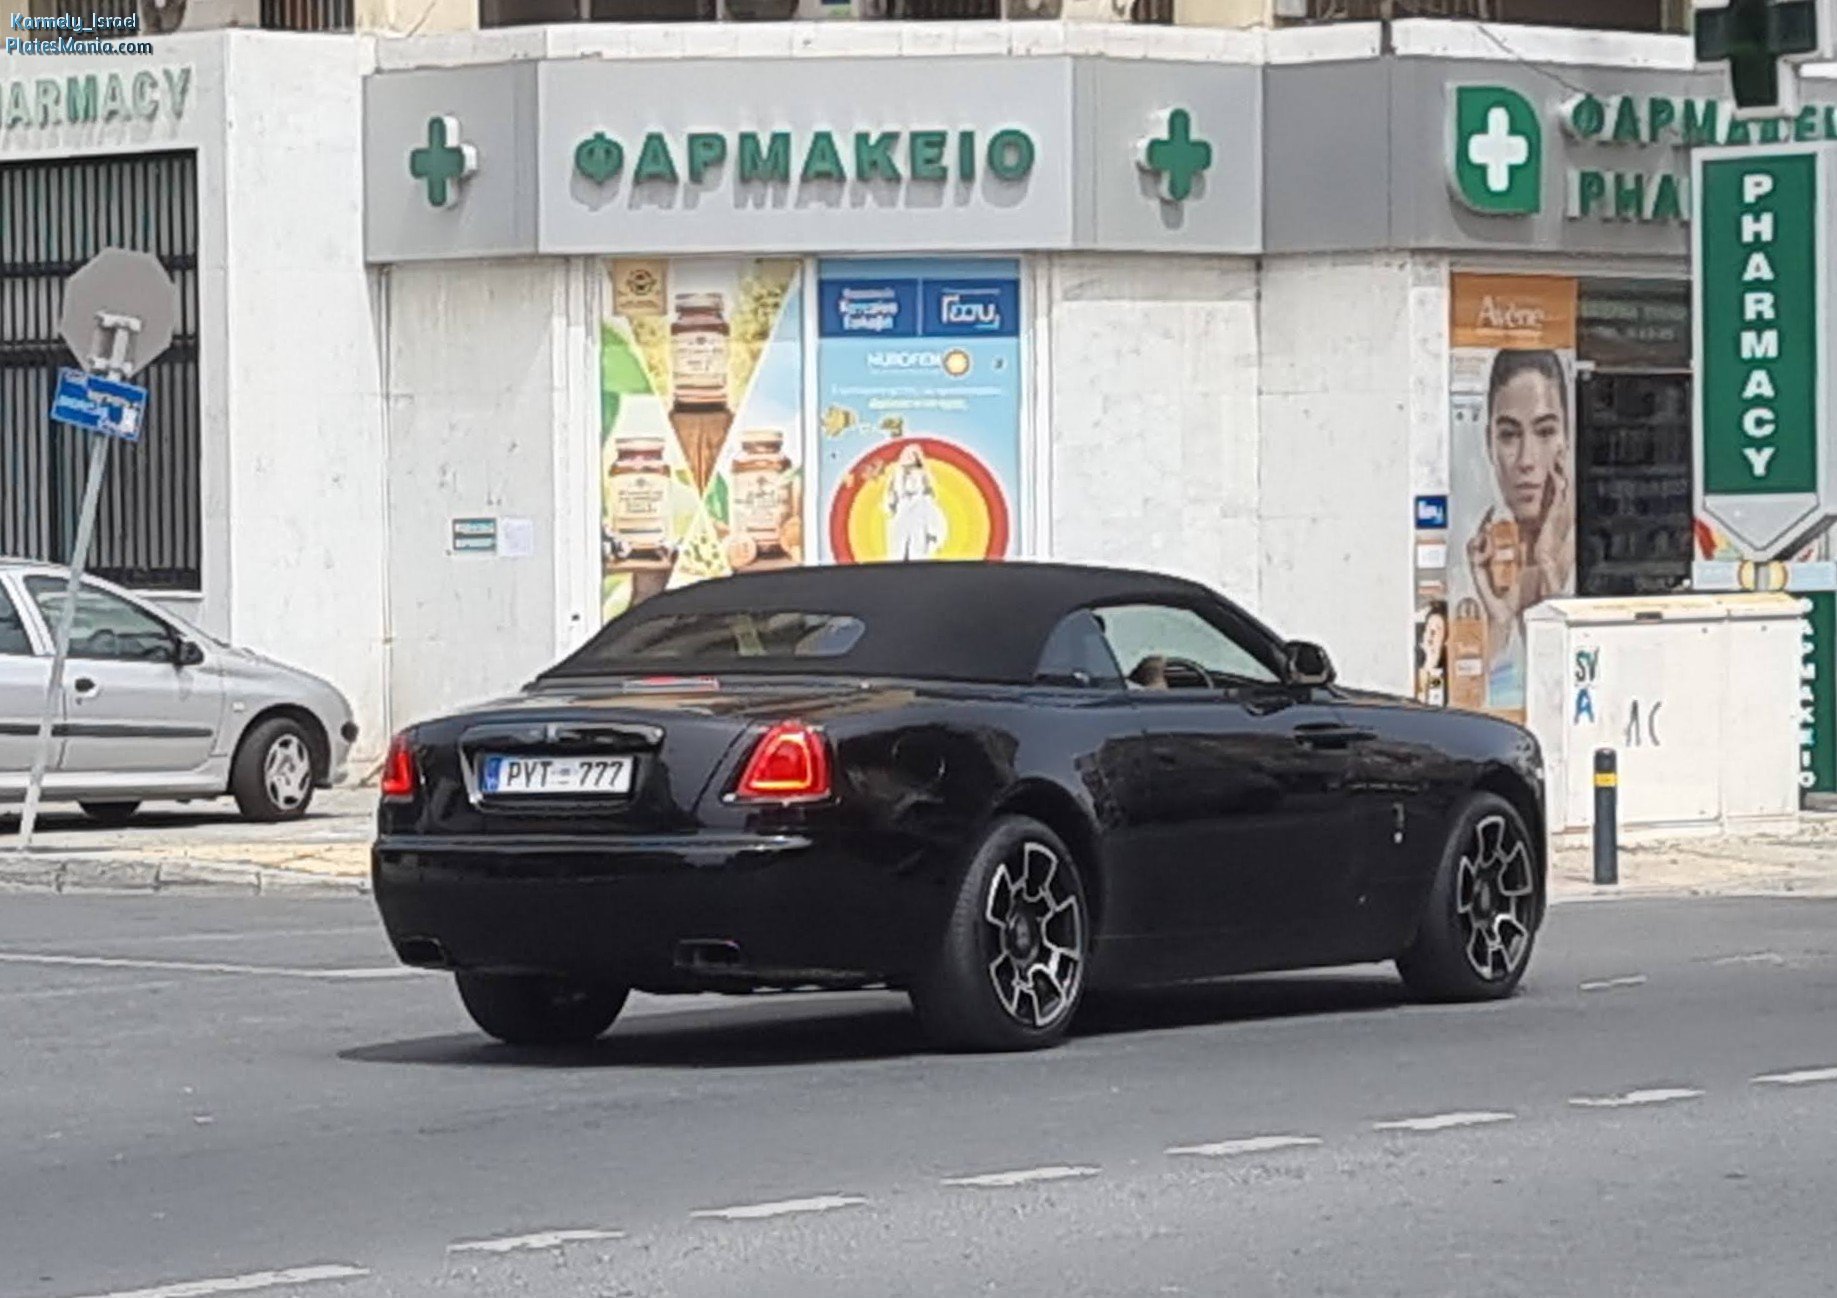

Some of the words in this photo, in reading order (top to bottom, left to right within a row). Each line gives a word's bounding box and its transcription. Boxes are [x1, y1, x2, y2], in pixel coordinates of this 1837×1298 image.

[0, 67, 192, 130] ARMACY
[573, 129, 1036, 185] ΦΑΡΜΑΚΕΙΟ
[1570, 170, 1690, 218] PHA
[1740, 173, 1779, 477] PHARMACY
[579, 760, 624, 788] 777
